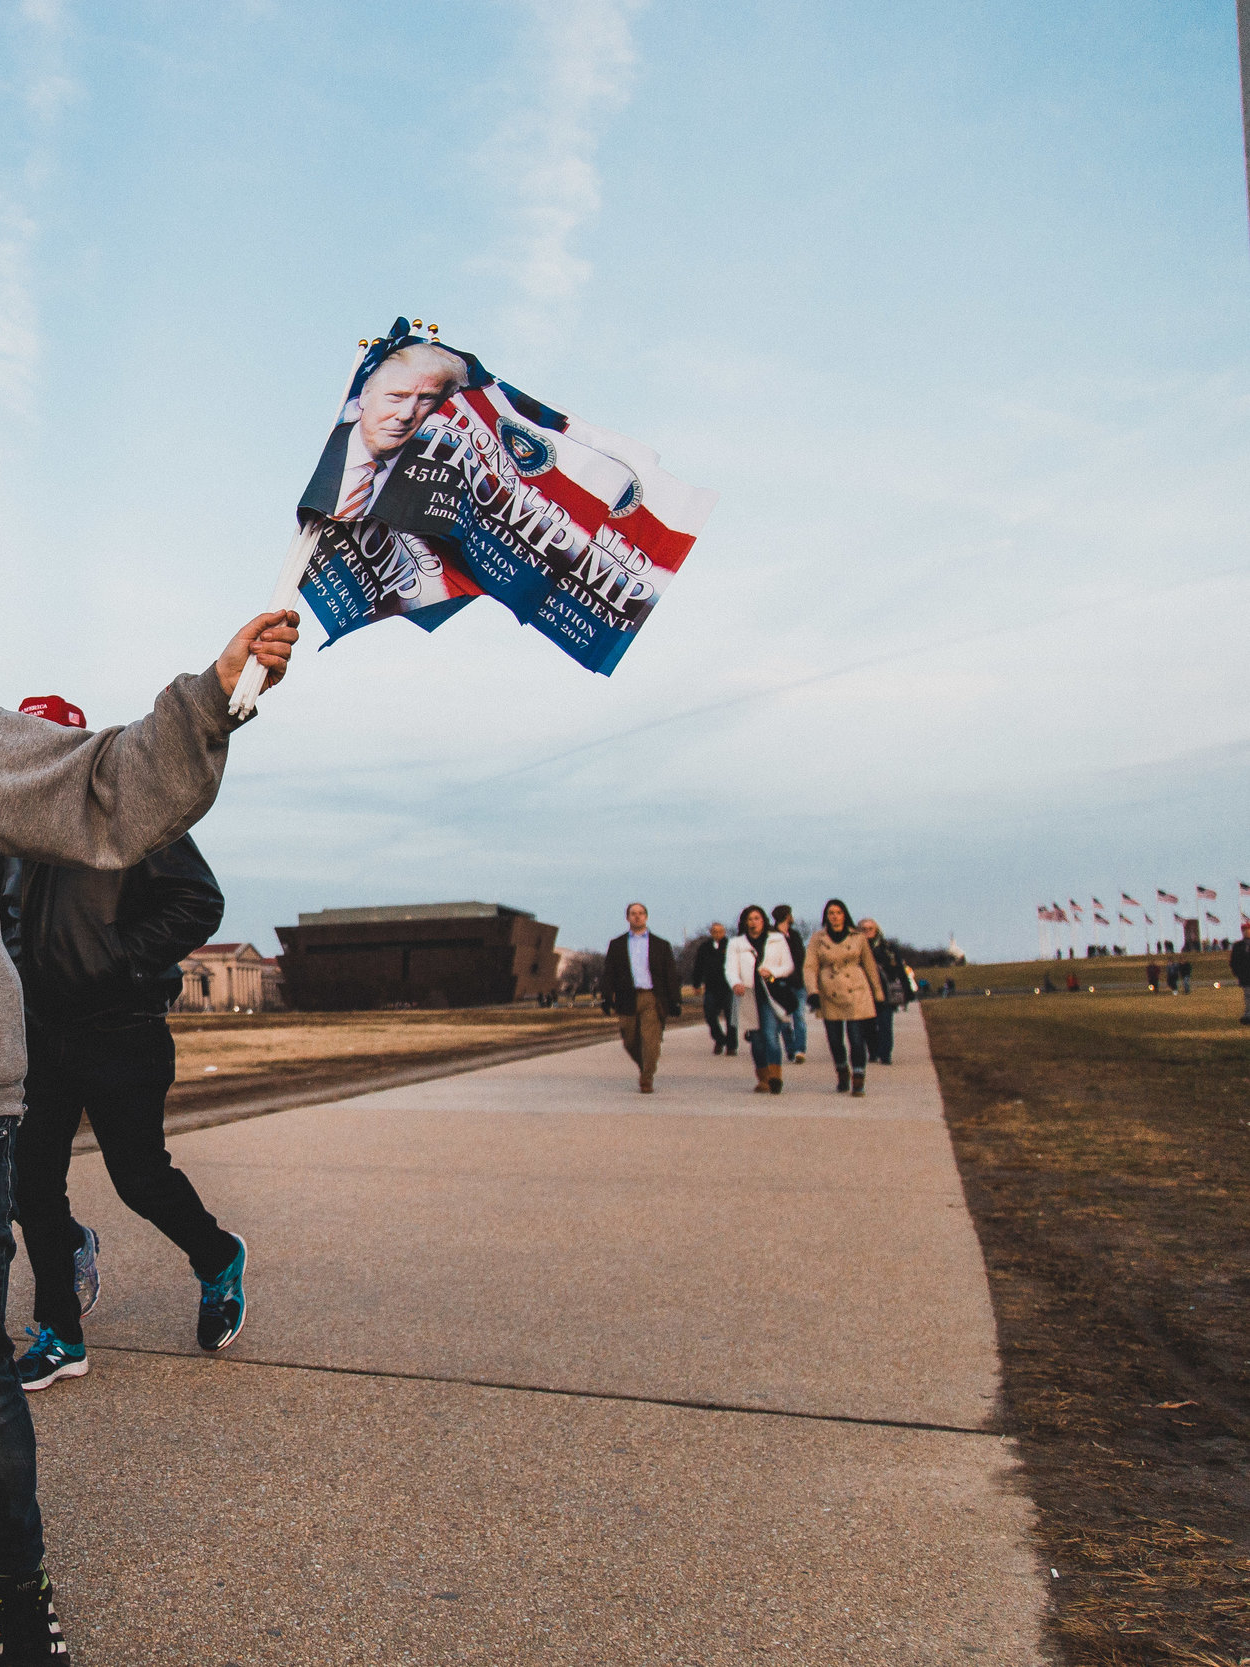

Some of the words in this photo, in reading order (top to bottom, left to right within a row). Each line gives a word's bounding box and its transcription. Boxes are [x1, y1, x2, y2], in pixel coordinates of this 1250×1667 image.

[404, 465, 450, 483] 45th
[418, 423, 575, 557] TRUMP
[480, 560, 512, 586] 2017
[545, 595, 597, 638] RATION
[556, 577, 635, 633] SIDENT
[538, 607, 558, 627] 20,
[560, 623, 589, 649] 2017
